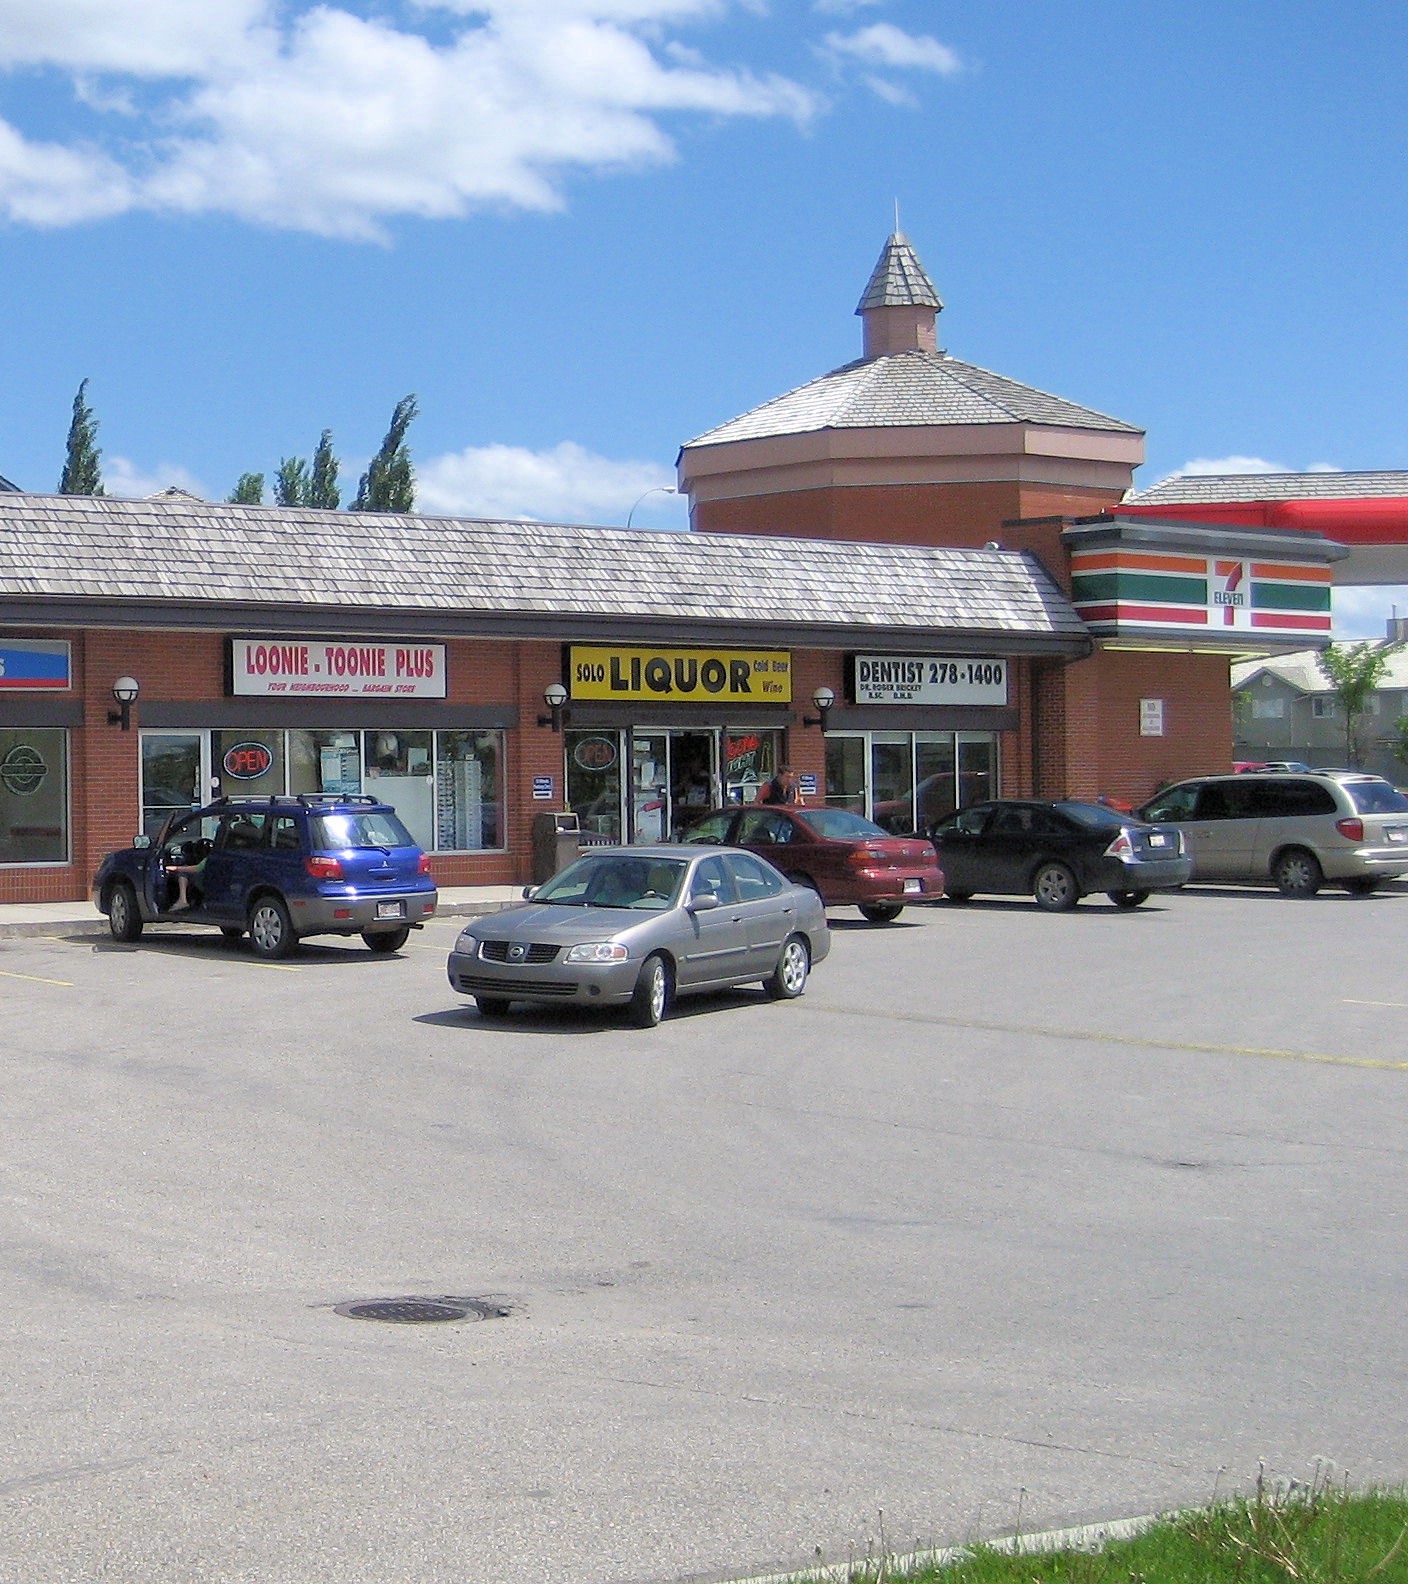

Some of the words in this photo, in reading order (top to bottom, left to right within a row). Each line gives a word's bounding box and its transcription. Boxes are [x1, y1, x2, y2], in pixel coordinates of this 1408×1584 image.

[246, 645, 309, 676] LOONIE
[325, 647, 386, 677] TOONIE
[395, 649, 434, 678] PLUS
[576, 663, 605, 683] SOLO
[610, 656, 752, 694] LIQUOR
[859, 661, 924, 683] DENTIST
[227, 750, 268, 771] OPEN
